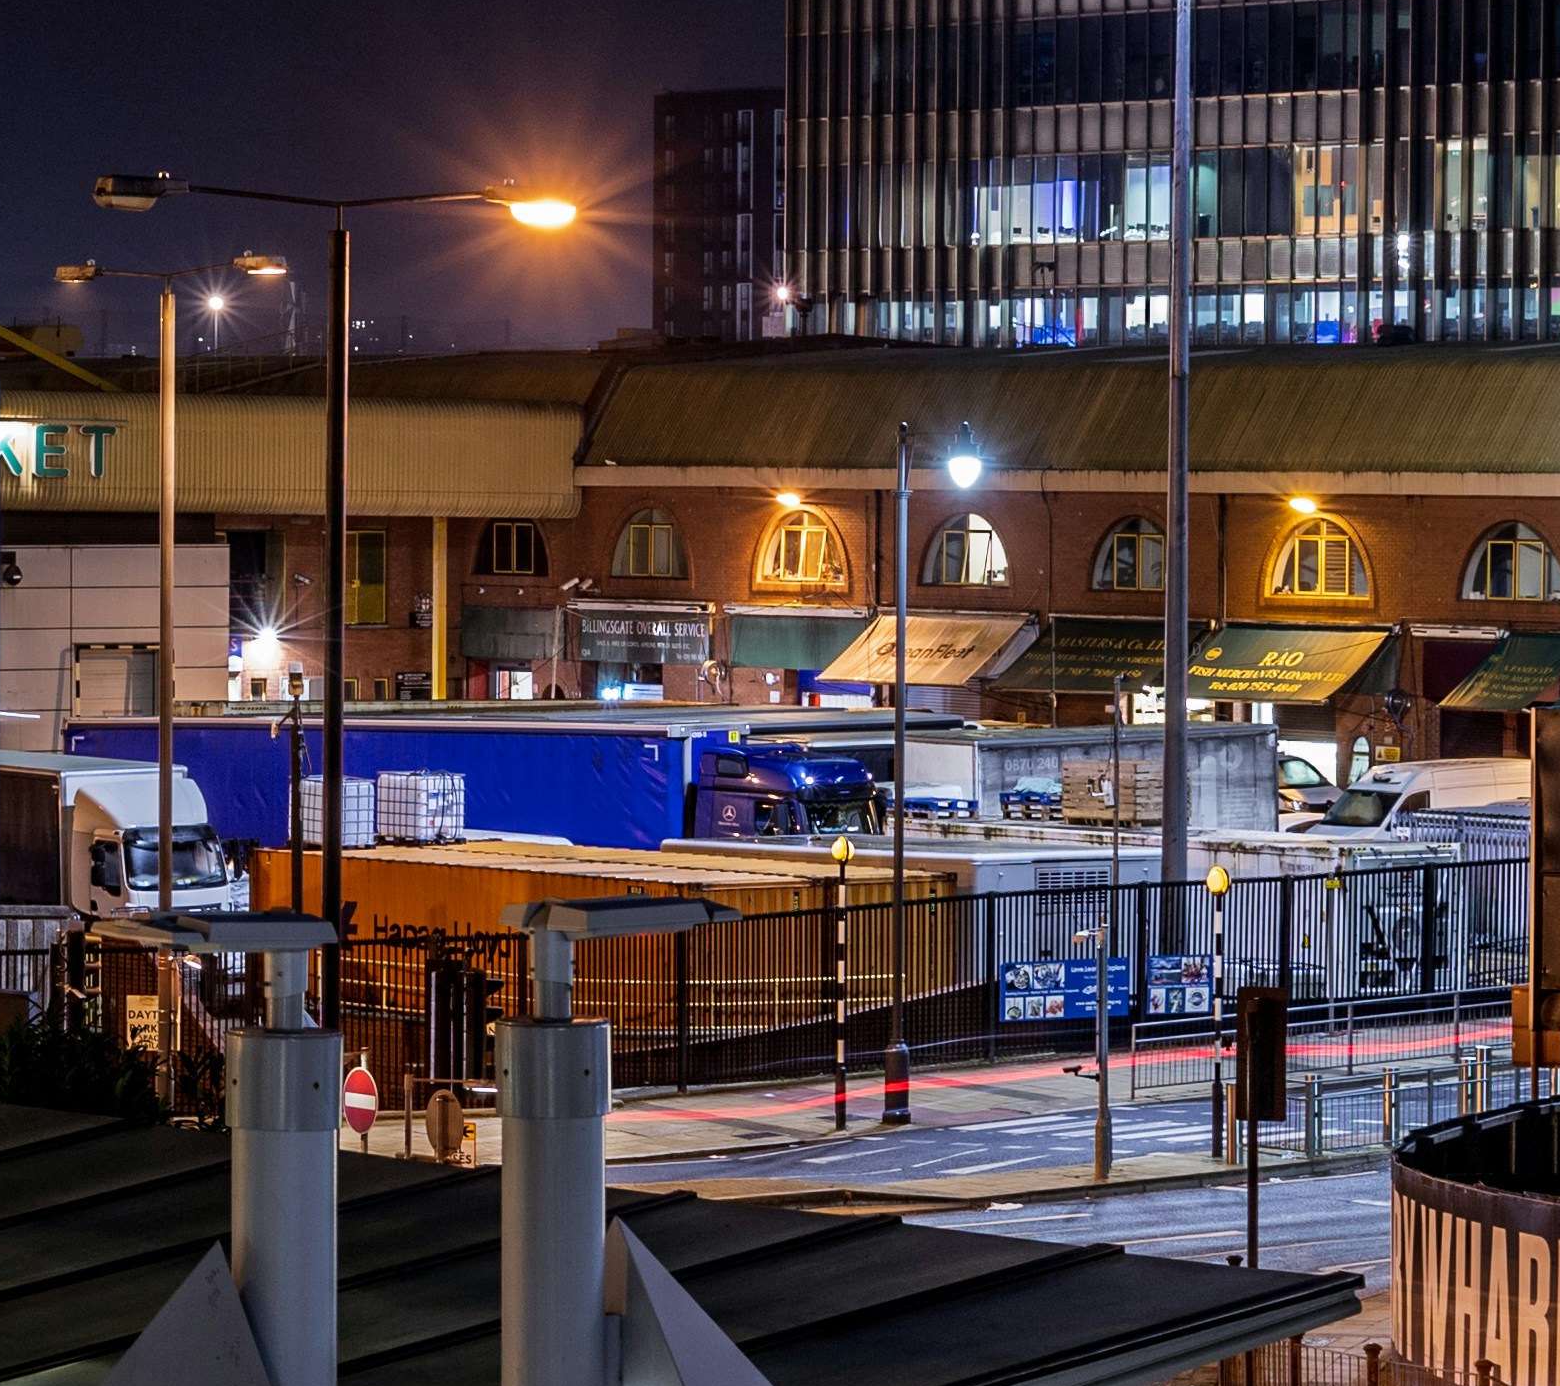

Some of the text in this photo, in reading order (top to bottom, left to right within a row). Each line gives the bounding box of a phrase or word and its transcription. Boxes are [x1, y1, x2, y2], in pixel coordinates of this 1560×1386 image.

[637, 621, 671, 636] OVERALL
[674, 622, 705, 638] SERVICE
[877, 642, 976, 660] OeanFleet
[1188, 665, 1215, 677] FISH
[1279, 670, 1322, 681] LONDON
